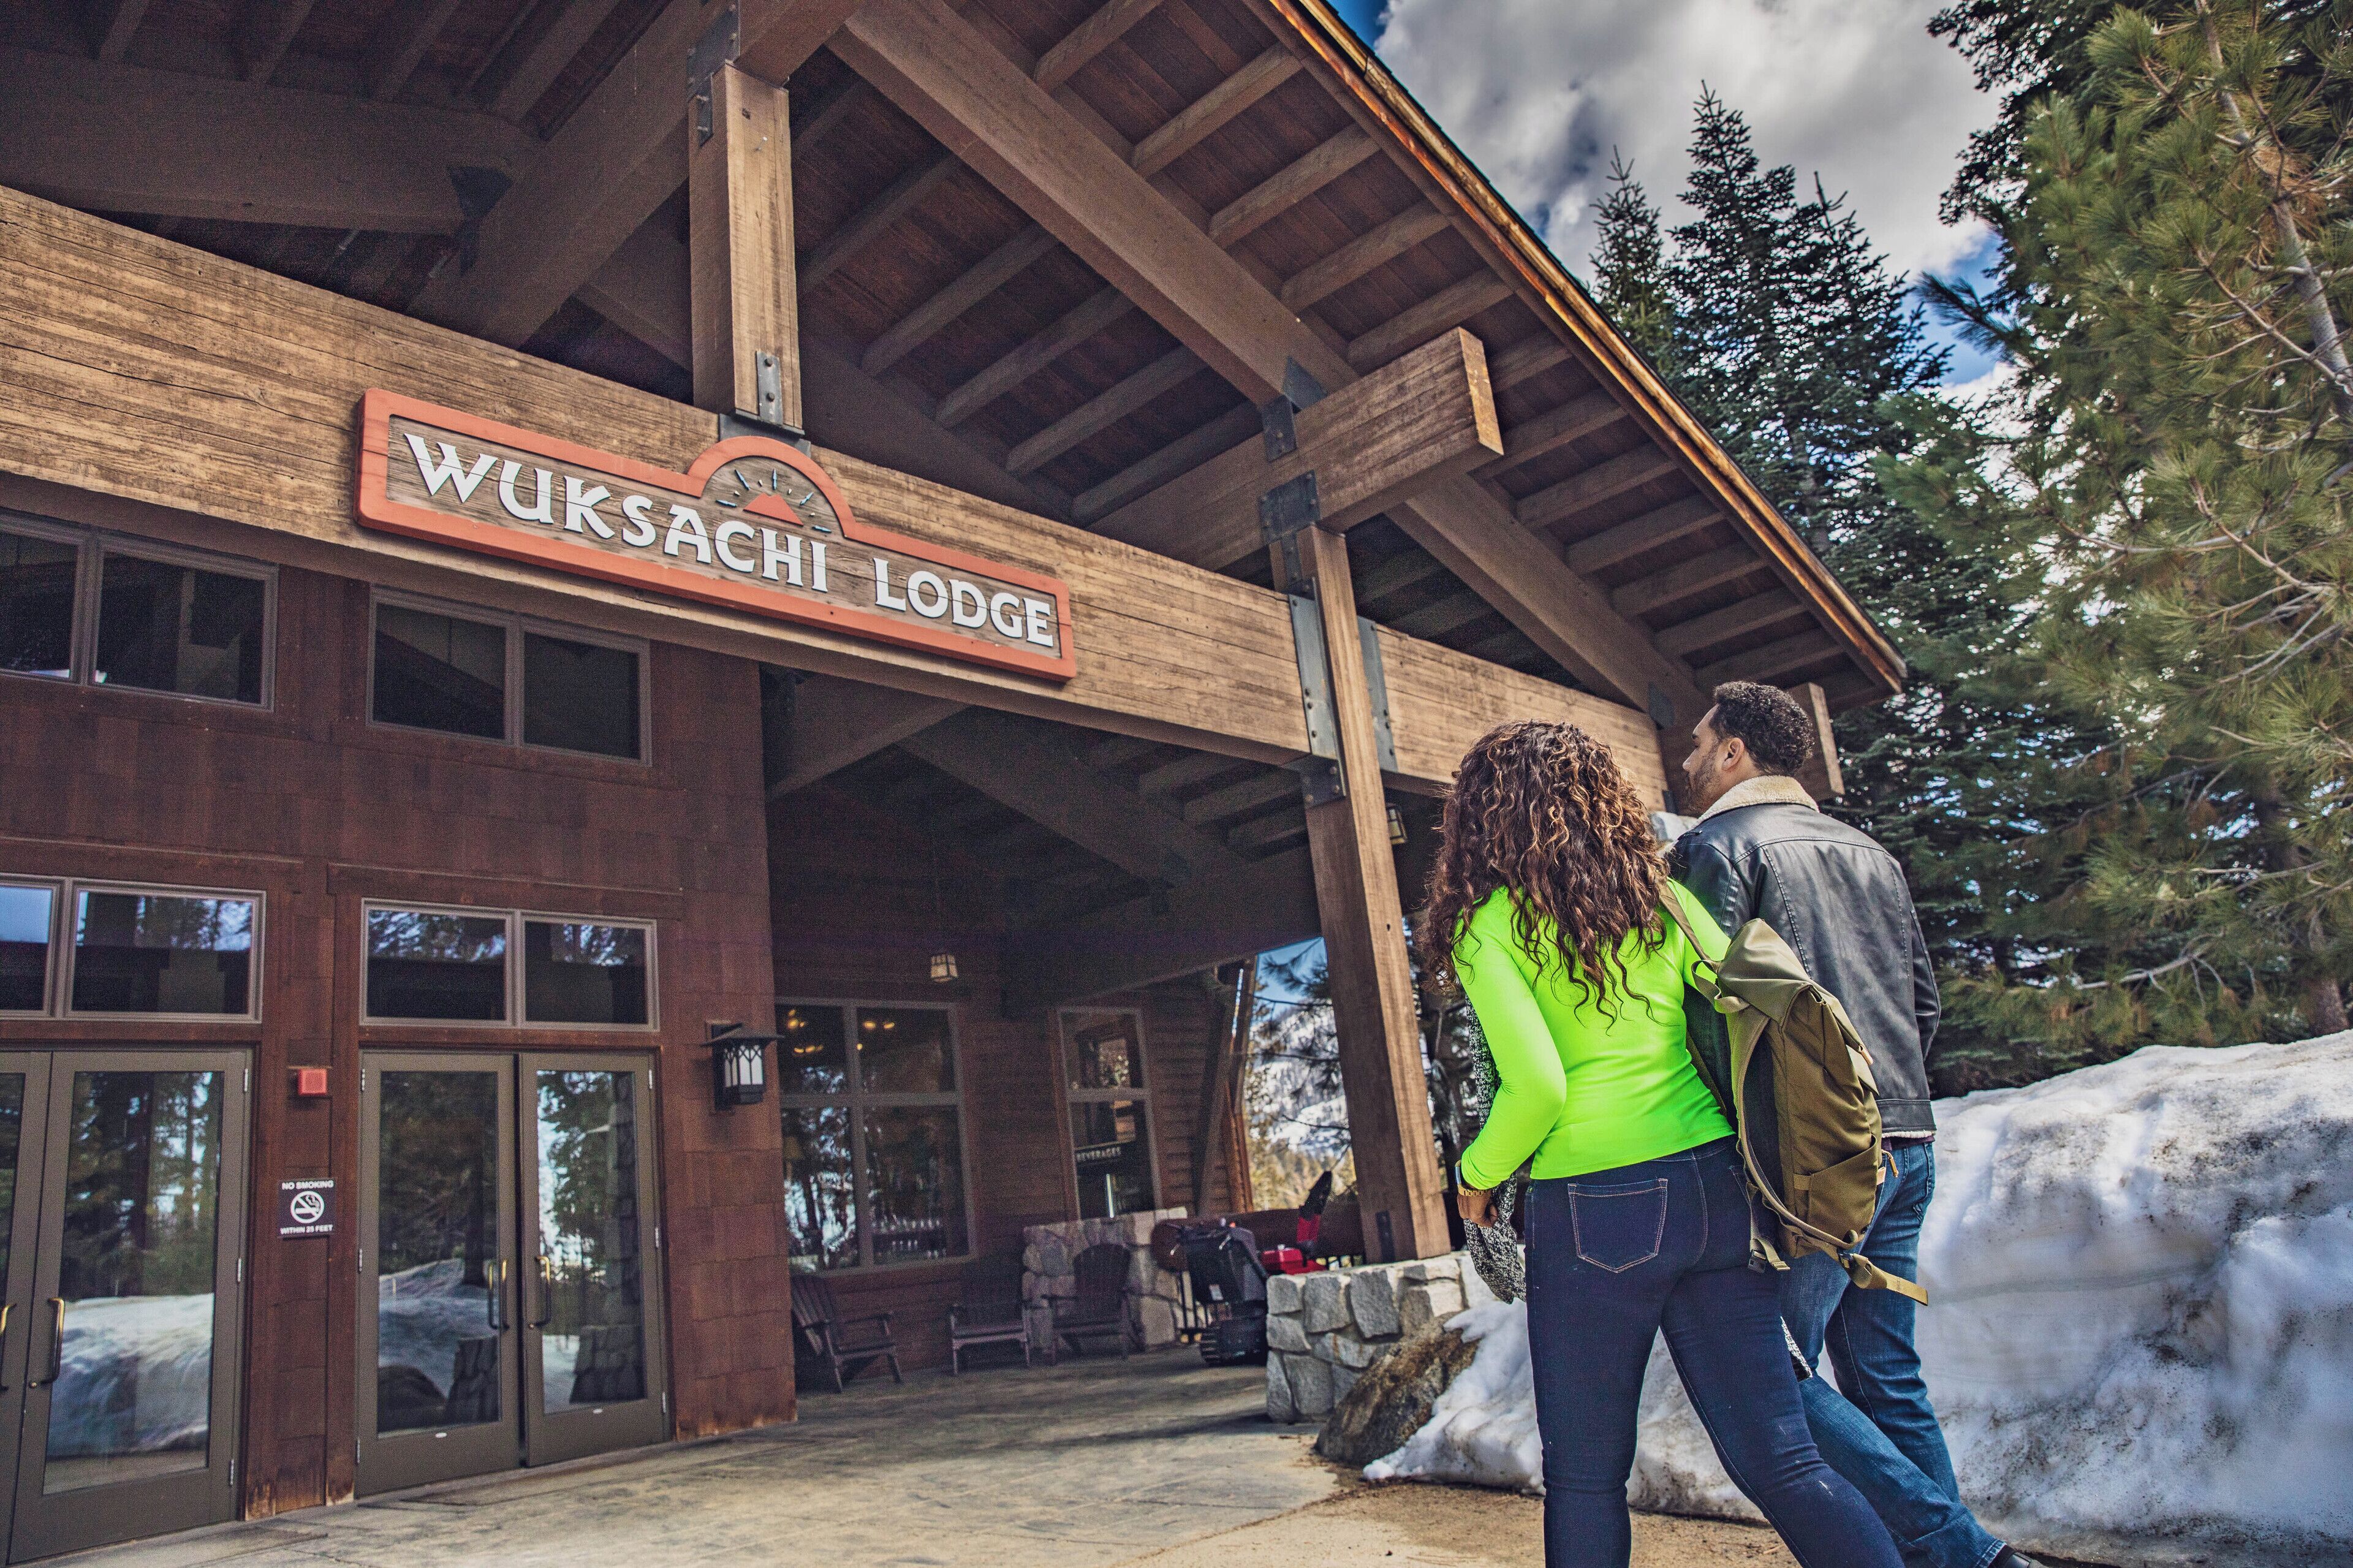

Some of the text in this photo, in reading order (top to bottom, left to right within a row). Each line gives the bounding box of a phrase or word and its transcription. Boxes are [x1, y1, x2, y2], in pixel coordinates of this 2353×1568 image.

[403, 433, 1054, 647] WUKSACHI LODGE
[296, 1180, 334, 1189] SMOKING
